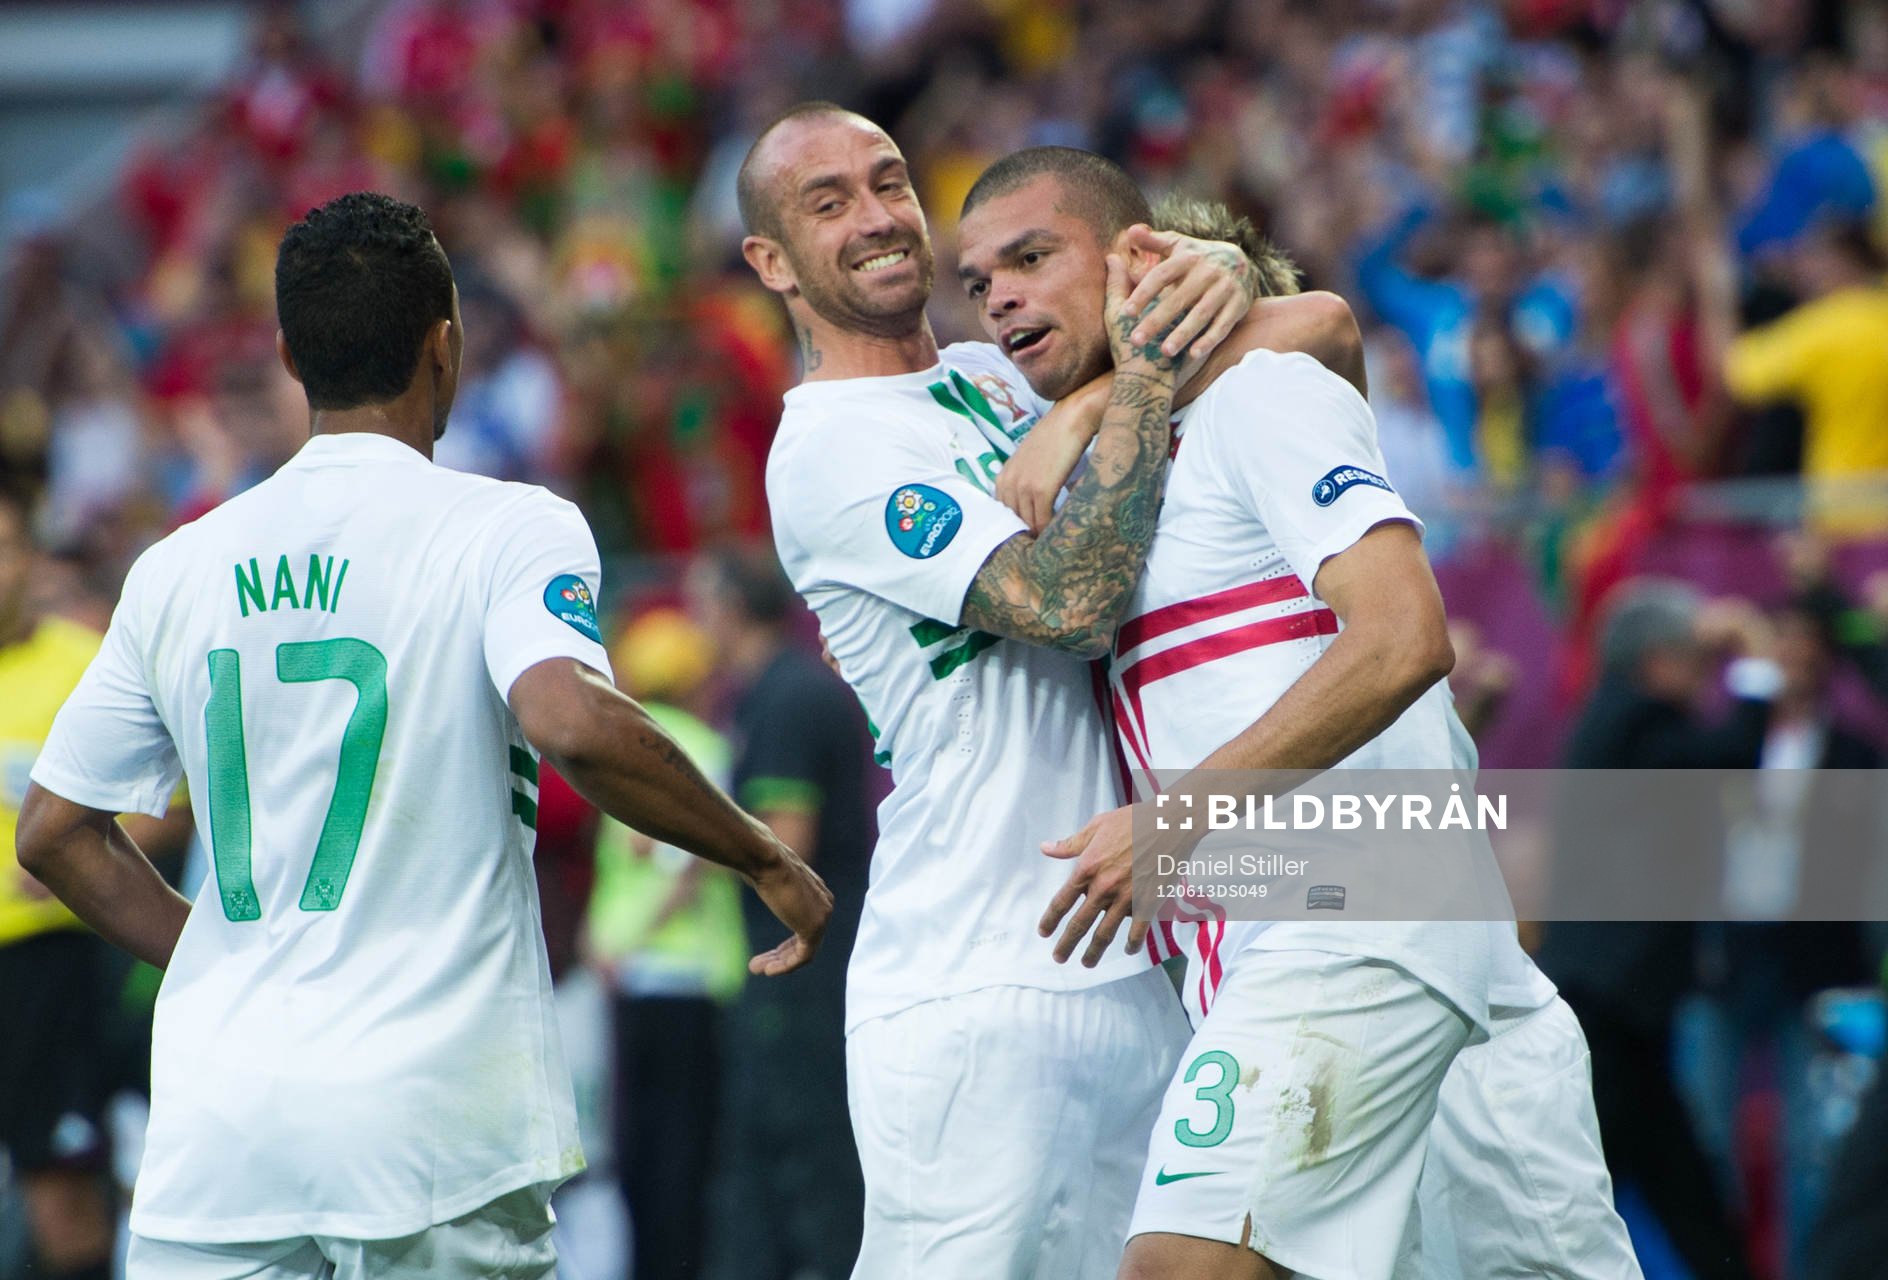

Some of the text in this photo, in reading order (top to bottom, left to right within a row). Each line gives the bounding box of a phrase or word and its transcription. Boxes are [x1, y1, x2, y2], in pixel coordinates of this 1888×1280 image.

[234, 553, 350, 617] NANI
[205, 637, 388, 922] 17
[1174, 1050, 1240, 1148] 3
